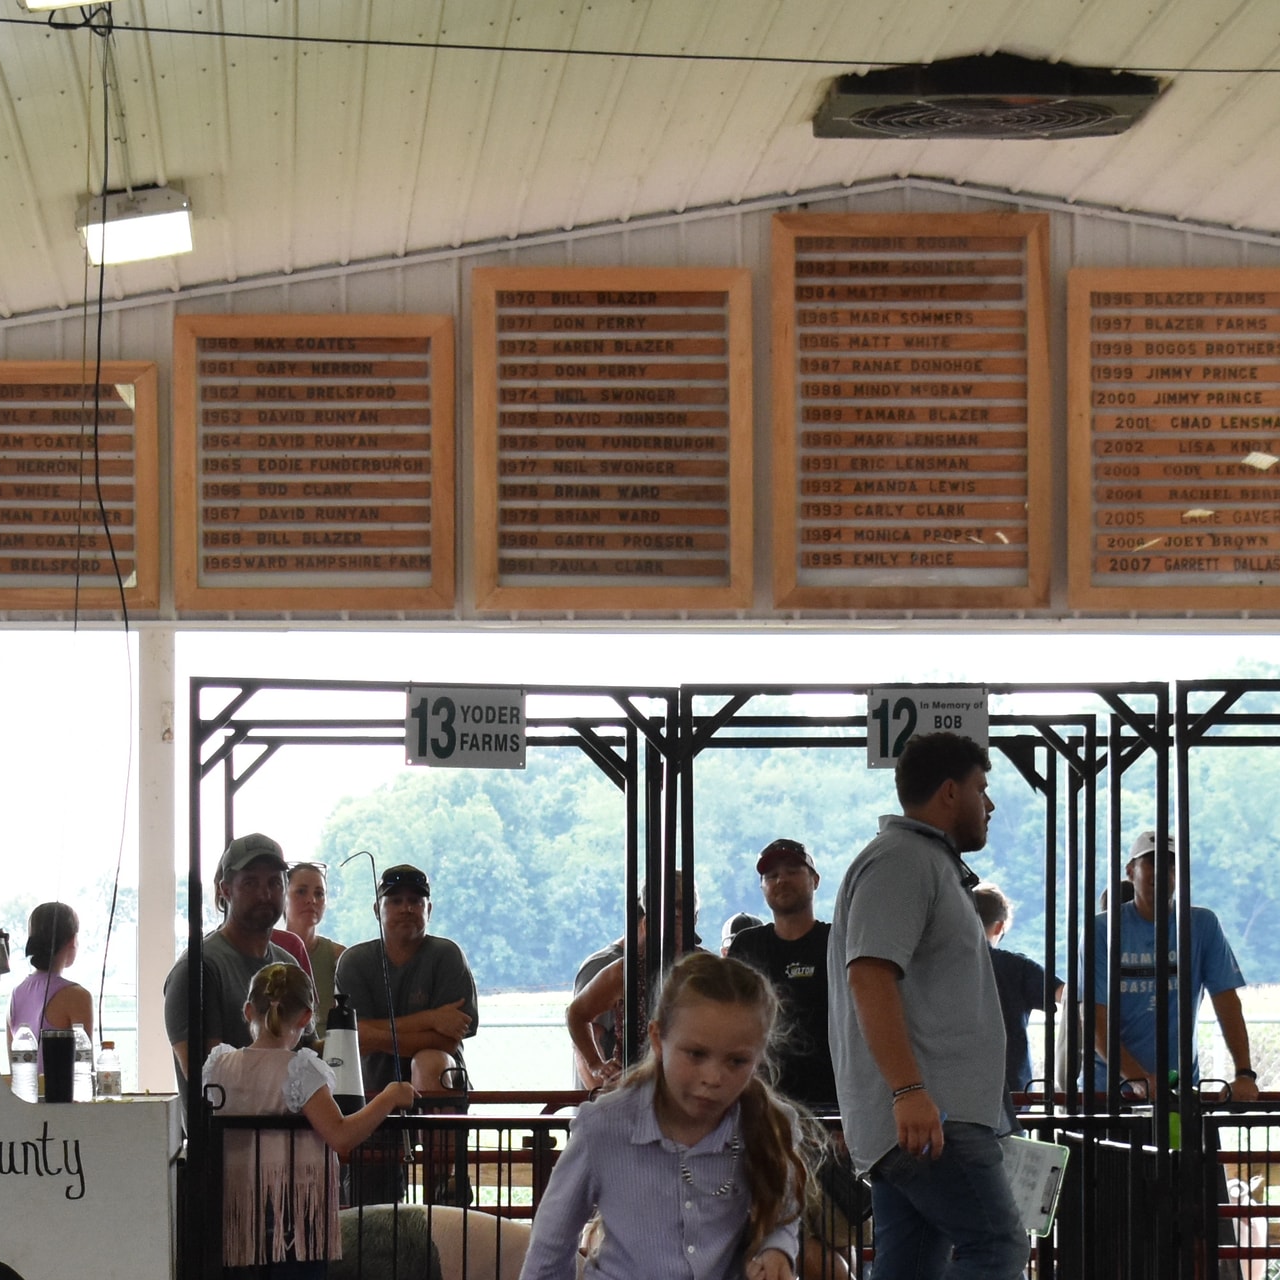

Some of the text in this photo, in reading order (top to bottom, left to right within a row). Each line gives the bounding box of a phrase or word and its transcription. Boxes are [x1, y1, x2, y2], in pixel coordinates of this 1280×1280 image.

[1097, 293, 1265, 304] 1996 BLAZER FARMS
[501, 317, 646, 329] 1971 DON PERRY
[850, 312, 889, 324] MARK
[901, 313, 973, 324] SOMMERS
[1097, 319, 1267, 329] 1997 BLAZER FARMS
[501, 341, 674, 353] 1972 KAREN BLAZER
[1097, 343, 1132, 355] 1998
[202, 362, 372, 374] 1961 GARY HERRON
[501, 365, 647, 376] 1973 DON PERRY
[803, 359, 983, 371] 1987 RANAE DONOHOE
[1097, 368, 1258, 379] 1999 JIMMY PRINCE
[202, 386, 396, 398] 1962 NOEL BRELSFORD
[501, 389, 537, 401] 1974
[601, 389, 675, 401] SWONGER
[805, 384, 841, 395] 1988
[854, 384, 900, 396] MINDY
[1098, 393, 1262, 404] 2000 JIMMY PRINCE
[203, 410, 378, 423] 1963 DAVID RUNYAN
[555, 413, 601, 424] DAVID
[615, 413, 687, 424] JOHNSON
[806, 409, 988, 421] 1989 TAMARA BLAZER
[1116, 417, 1150, 429] 2001
[1171, 417, 1210, 428] CHAD
[204, 435, 378, 447] 1964 DAVID RUNYAN
[556, 437, 586, 448] DON
[854, 434, 894, 446] MARK
[906, 434, 978, 446] LENSMAN
[1104, 441, 1272, 453] 2002 LISA KNOX
[17, 460, 78, 472] HERRON
[204, 459, 423, 471] 1965 EDDIE FUNDERBURGH
[502, 462, 675, 473] 1977 NEIL SWONGER
[804, 458, 969, 469] 1991 ERIC LENSMAN
[1104, 465, 1140, 476] 2003
[1164, 465, 1201, 475] CODY
[806, 481, 975, 492] 1992 AMANDA LEWIS
[43, 509, 121, 521] FAULKNER
[204, 507, 379, 520] 1967 DAVID RUNYAN
[806, 505, 965, 516] 1993 CARLY CLARK
[1105, 512, 1144, 525] 2005
[36, 535, 97, 546] COATES
[555, 535, 605, 546] GARTH
[623, 535, 693, 547] PROSSER
[806, 530, 842, 541] 1994
[854, 530, 910, 541] MONICA
[1164, 537, 1205, 547] JOEY
[1213, 536, 1268, 546] BROWN
[11, 559, 100, 571] BRELSFORD
[806, 553, 954, 565] 1995 EMILY PRICE
[1109, 557, 1280, 571] 2007 GARRETT DALLAS
[920, 701, 983, 710] In Memory of
[460, 706, 520, 724] YODER
[411, 697, 456, 759] 13
[872, 697, 917, 758] 12
[935, 716, 962, 729] BOB
[460, 734, 519, 752] FARMS
